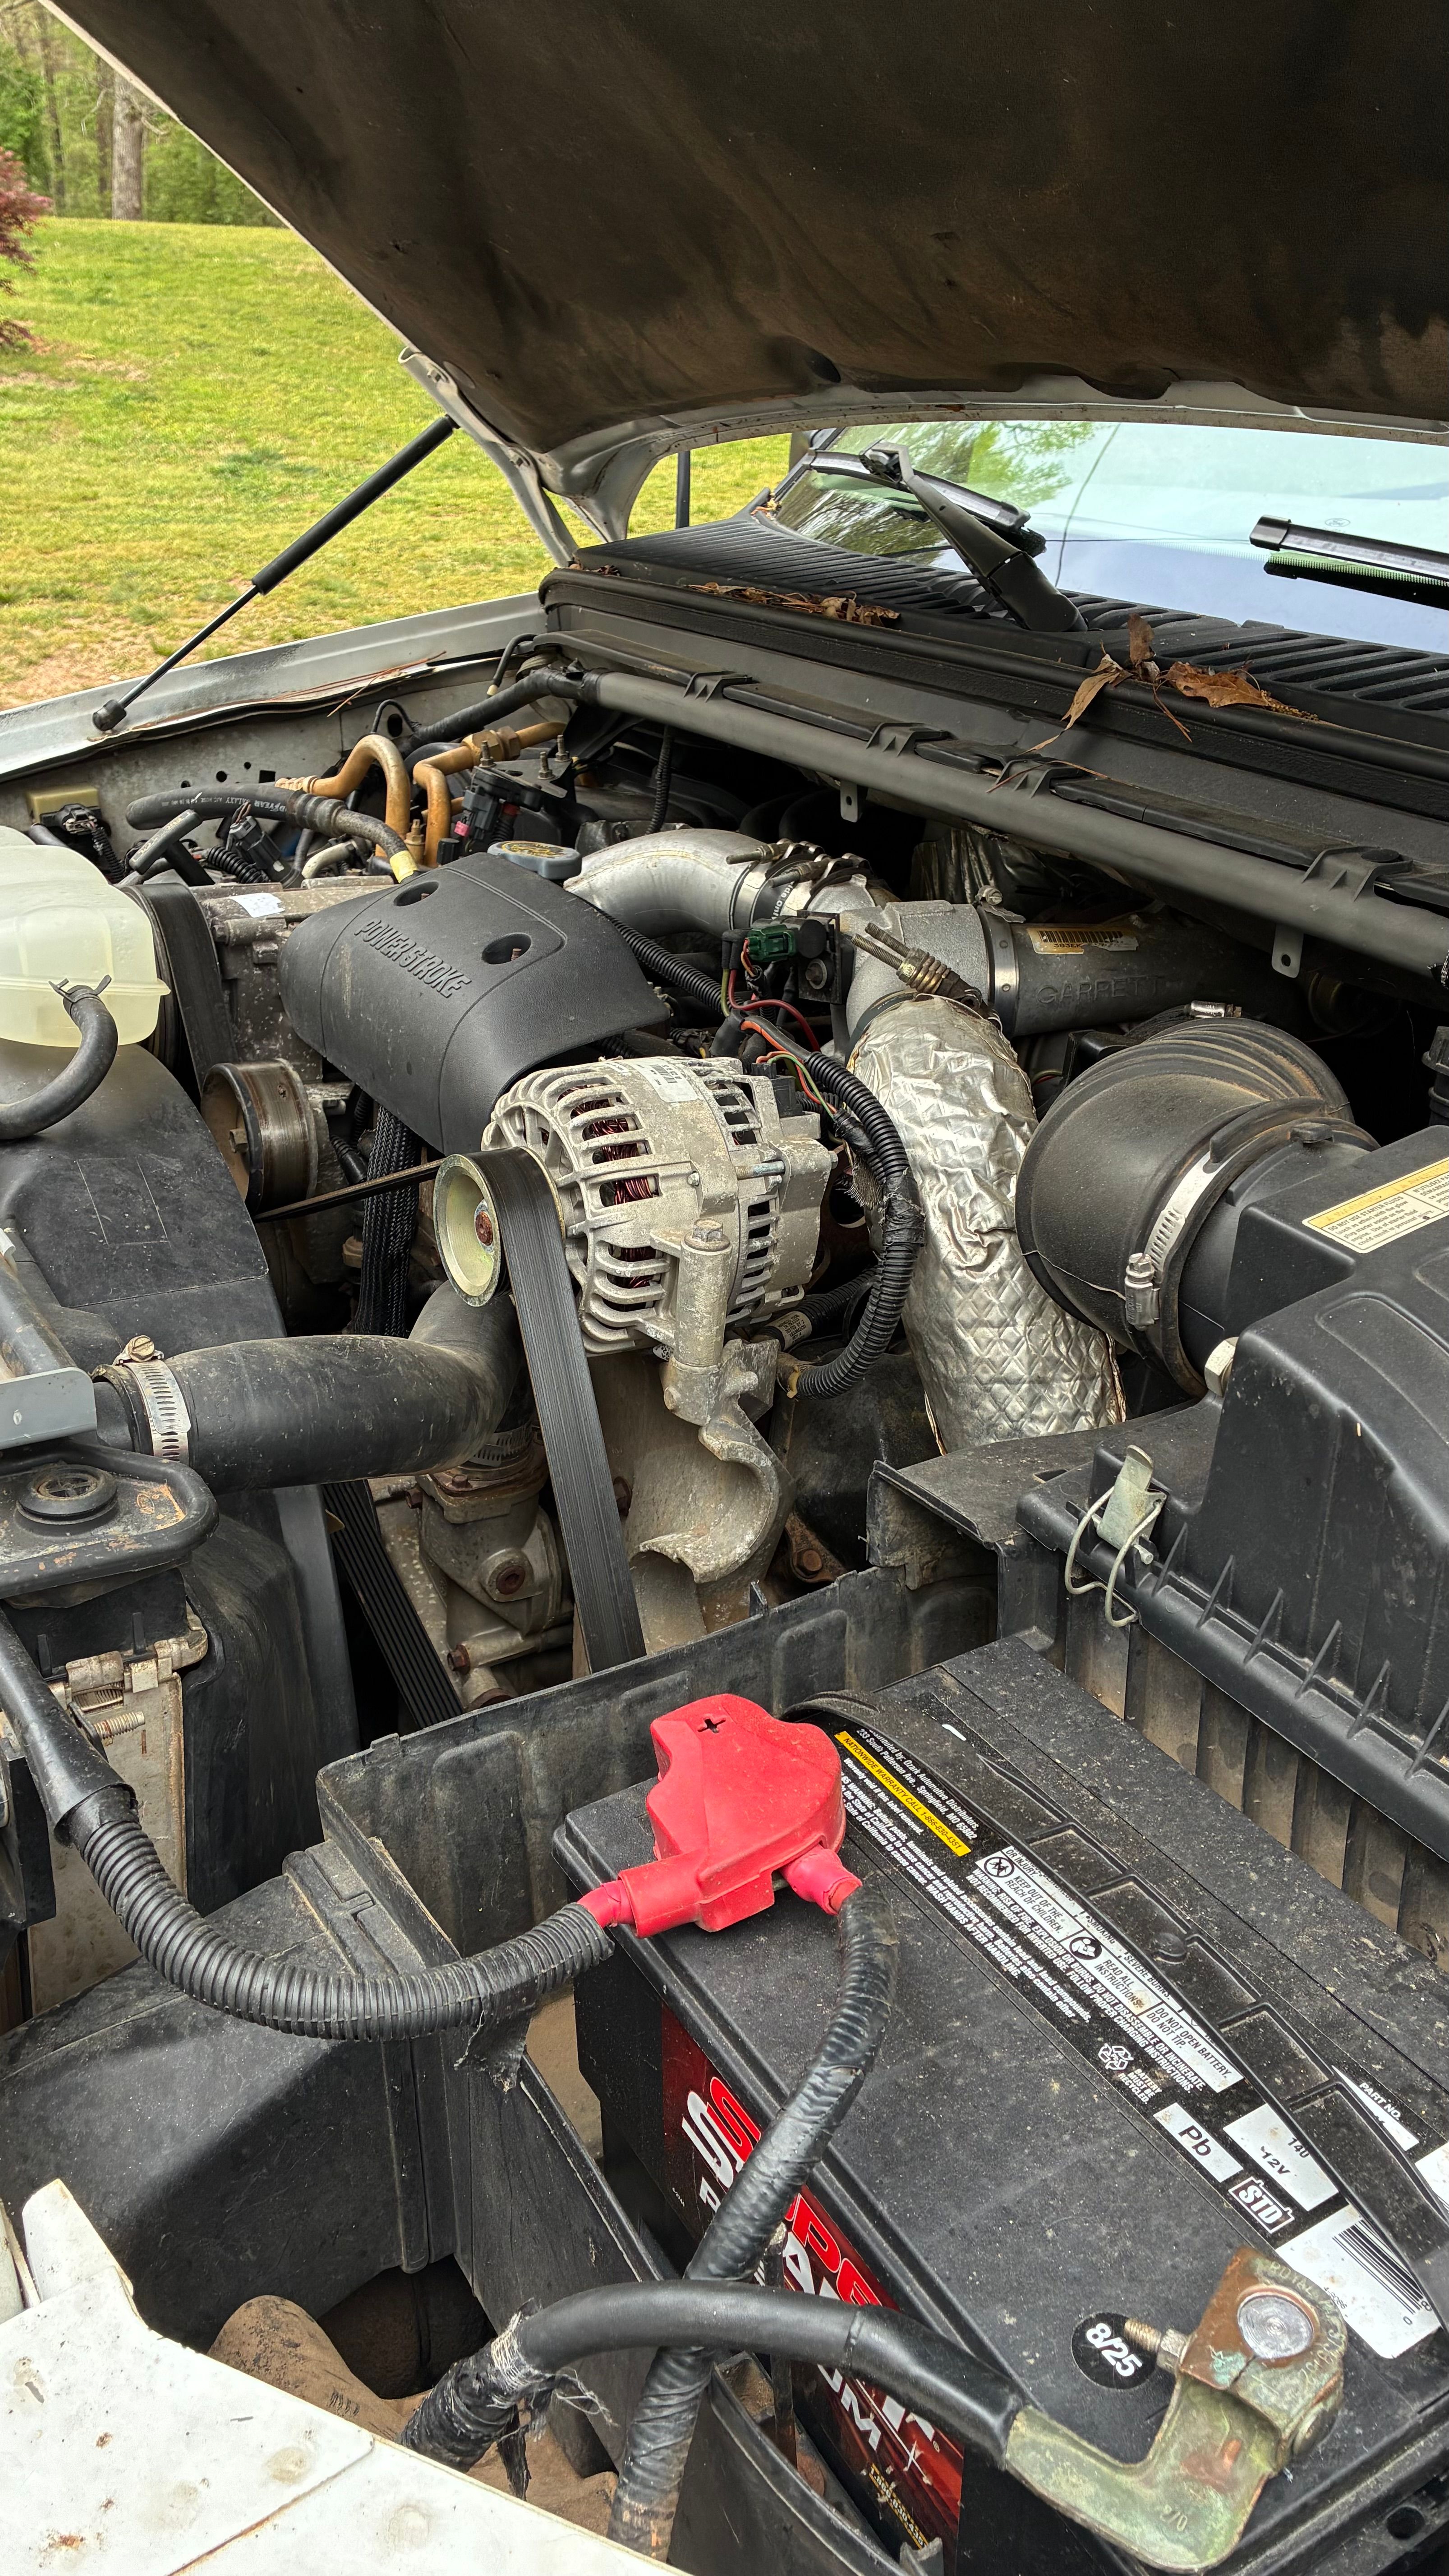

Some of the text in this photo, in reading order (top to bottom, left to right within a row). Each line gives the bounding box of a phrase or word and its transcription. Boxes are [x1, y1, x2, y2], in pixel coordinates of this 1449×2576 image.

[1360, 1204, 1385, 1216] STARTER
[1384, 1196, 1404, 1205] FLUIDS
[843, 1738, 962, 1849] NATIONWIDE WARRANTY CALL 1-866-830-4351
[843, 1790, 854, 1800] the
[843, 1757, 866, 1780] Warranty
[863, 1778, 878, 1789] void
[877, 1791, 889, 1802] this
[886, 1800, 903, 1814] label
[898, 1812, 924, 1835] removed.
[856, 1729, 870, 1739] 233
[866, 1737, 883, 1753] South
[880, 1751, 906, 1775] Patterson
[916, 1785, 949, 1815] Springfield,
[946, 1812, 961, 1824] MO
[956, 1822, 977, 1840] 65802
[903, 1760, 921, 1775] Ozark
[919, 1773, 948, 1800] Automotive
[945, 1799, 979, 1831] Distributors,
[851, 1799, 867, 1813] State
[869, 1817, 897, 1842] California
[899, 1846, 918, 1863] cause
[1006, 1849, 1038, 1877] OR INJURY.
[915, 1862, 936, 1880] cancer
[932, 1879, 948, 1891] and
[841, 1802, 859, 1816] State
[861, 1820, 888, 1846] California
[891, 1850, 909, 1867] cause
[906, 1865, 927, 1886] cancer.
[925, 1884, 948, 1904] WASH
[943, 1902, 969, 1924] HANDS
[963, 1923, 989, 1944] AFTER
[984, 1942, 1021, 1979] HANDLING.
[1004, 1879, 1027, 1898] REACH
[1031, 1904, 1063, 1933] CHILDREN.
[1013, 1876, 1031, 1888] KEEP
[1027, 1889, 1044, 1900] OUT
[1048, 1907, 1063, 1919] THE
[871, 1808, 894, 1828] Battery
[889, 1826, 908, 1843] posts,
[906, 1840, 934, 1867] terminals
[930, 1865, 946, 1877] and
[941, 1875, 965, 1895] related
[960, 1894, 995, 1927] accessories
[992, 1925, 1017, 1947] contain
[1013, 1945, 1032, 1961] lead
[1026, 1959, 1044, 1973] and
[1039, 1970, 1058, 1986] lead
[1049, 1985, 1091, 2023] compounds,
[939, 1890, 980, 1925] reproductive
[976, 1922, 995, 1941] harm.
[994, 1939, 1023, 1966] Batteries
[966, 1874, 1194, 2093] NOT RECOMMENDED FOR INVERTED USE. FOLLOW PROPER CHARGING INSTRUCTIONS.
[1019, 1965, 1036, 1980] also
[1093, 1963, 1145, 2010] INSTRUCTIONS.
[1103, 1959, 1134, 1987] READ ALL
[997, 1892, 1015, 1907] RISK
[1010, 1904, 1023, 1913] OF
[1017, 1912, 1035, 1927] FIRE,
[1031, 1925, 1066, 1956] EXPLOSION
[1062, 1954, 1075, 1964] OR
[1070, 1962, 1095, 1985] BURNS.
[1092, 1983, 1106, 1993] DO
[1101, 1992, 1119, 2005] NOT
[1114, 2003, 1159, 2045] DISASSEMBLE
[1155, 2042, 1169, 2054] OR
[1164, 2052, 1206, 2091] INCINERATE.
[1033, 1978, 1059, 2002] contain
[1055, 2001, 1076, 2018] other
[1146, 2012, 1160, 2023] DO
[1156, 2022, 1175, 2036] NOT
[1171, 2034, 1186, 2049] TIP.
[1155, 2007, 1169, 2018] DO
[1165, 2017, 1184, 2031] NOT
[1180, 2030, 1202, 2049] OPEN
[1197, 2047, 1232, 2078] BATTERY.
[1116, 2073, 1149, 2105] RECYCLED.
[1127, 2072, 1155, 2098] MUST BE
[1134, 2068, 1163, 2093] BATTERY
[1359, 2082, 1402, 2121] PART NO.
[1178, 2125, 1212, 2157] Pb
[1262, 2151, 1292, 2175] 12V
[1239, 2188, 1285, 2226] STD
[1086, 2322, 1143, 2378] 8/25
